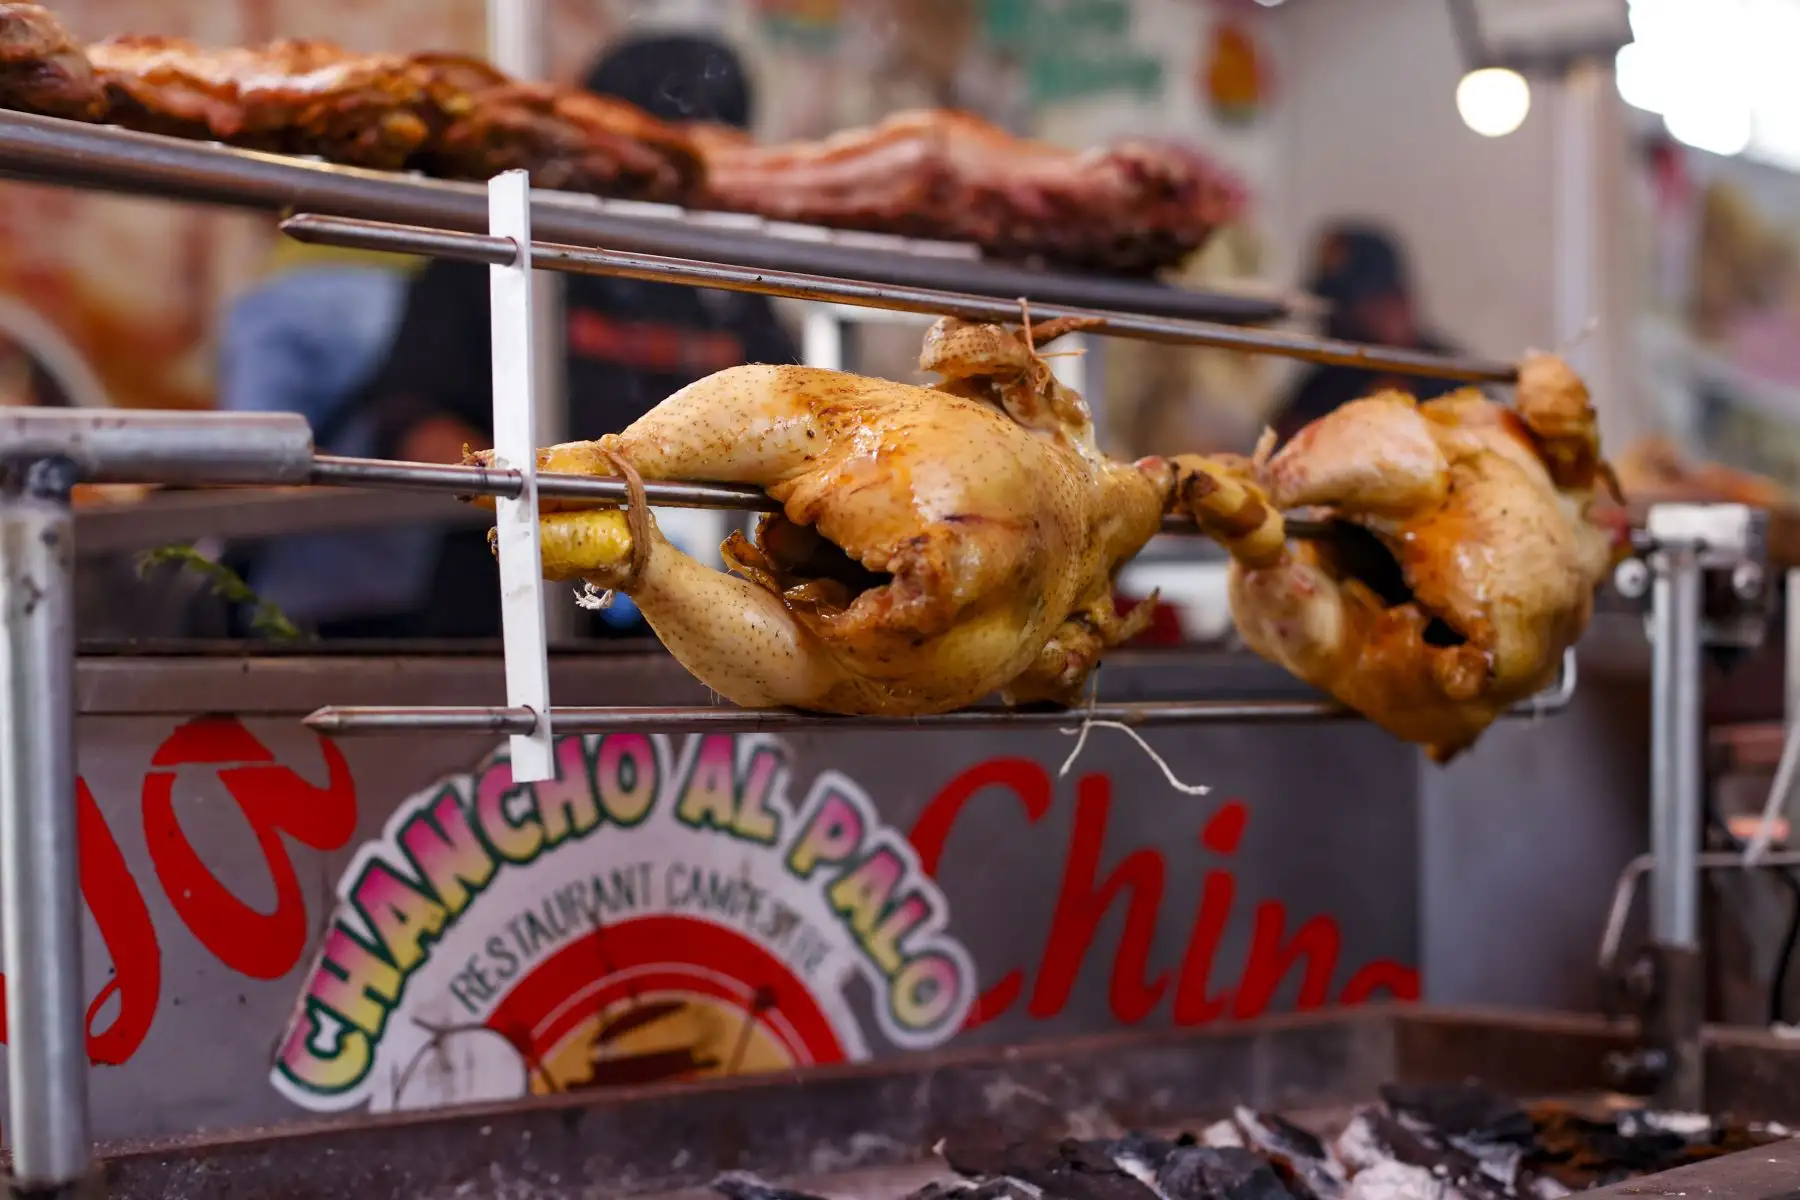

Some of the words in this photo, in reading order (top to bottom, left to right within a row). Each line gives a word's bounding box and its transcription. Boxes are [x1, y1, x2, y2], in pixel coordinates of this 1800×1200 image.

[275, 734, 661, 1095] CHANCHO
[674, 734, 782, 846] AL
[785, 785, 963, 1034] PALO
[448, 861, 656, 1015] RESTAURANT
